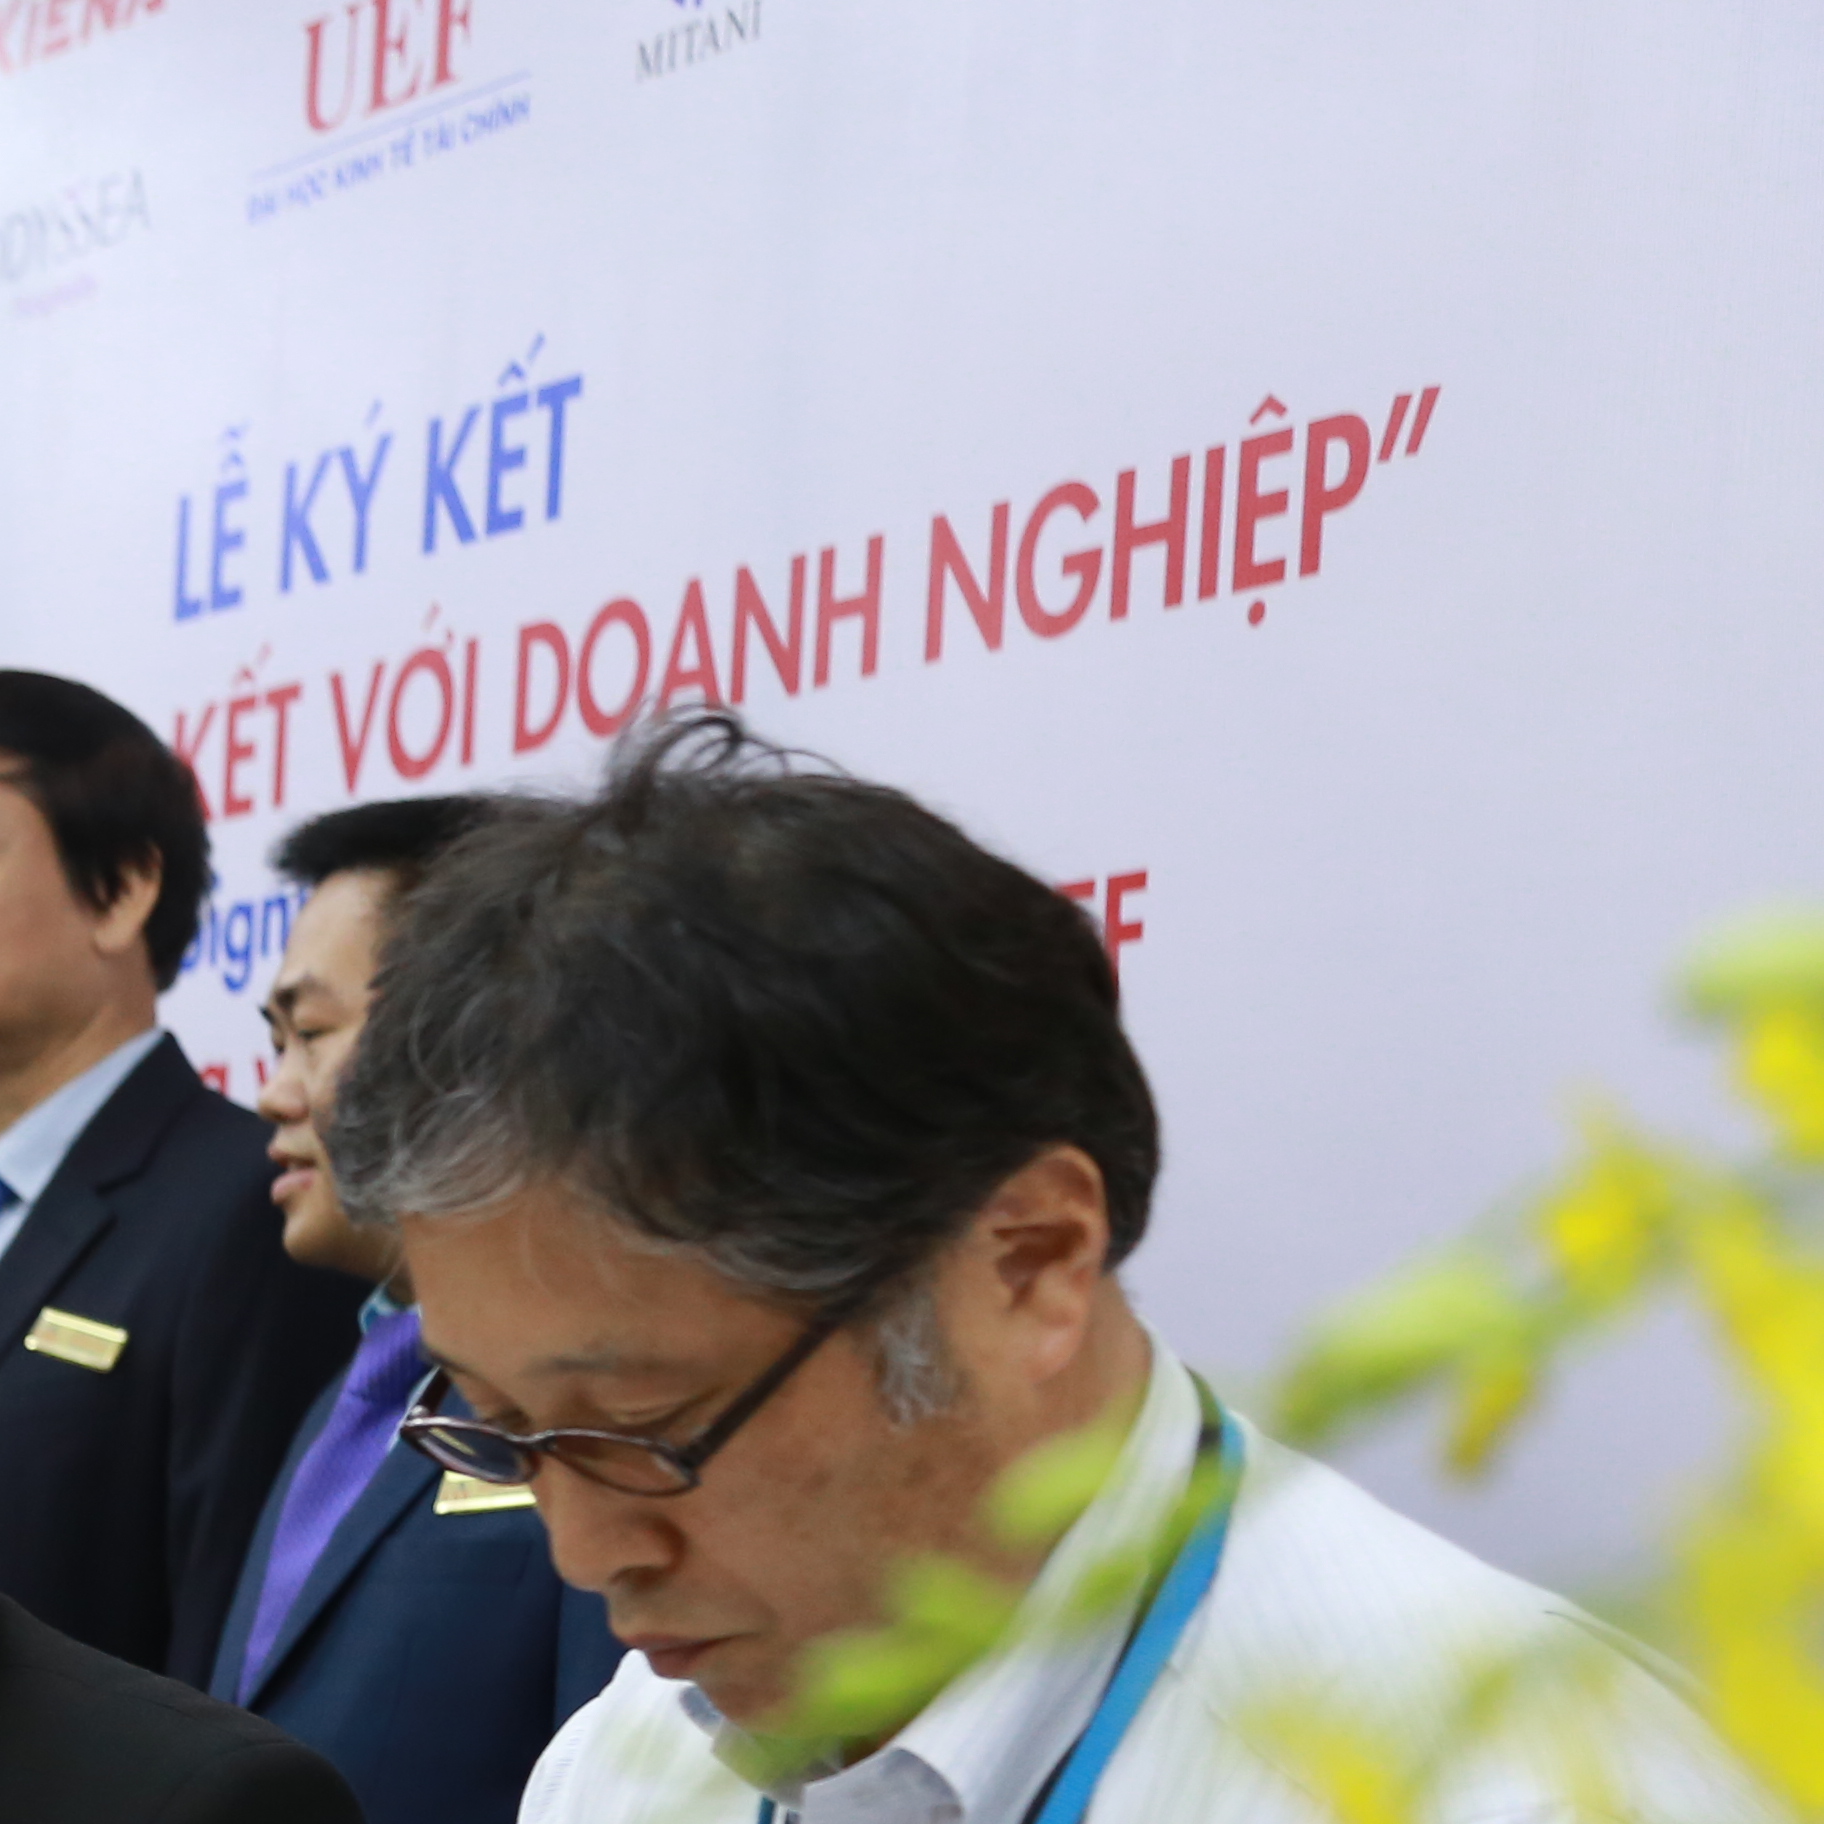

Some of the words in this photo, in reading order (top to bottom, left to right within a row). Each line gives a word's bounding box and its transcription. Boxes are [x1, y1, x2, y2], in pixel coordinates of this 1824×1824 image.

[304, 0, 473, 136] UEF
[636, 0, 761, 84] MITANI
[174, 422, 250, 624] LỄ
[277, 397, 394, 595] KÝ
[422, 331, 584, 556] KẾT
[330, 601, 478, 795] VỚI
[513, 532, 883, 756] DOANH
